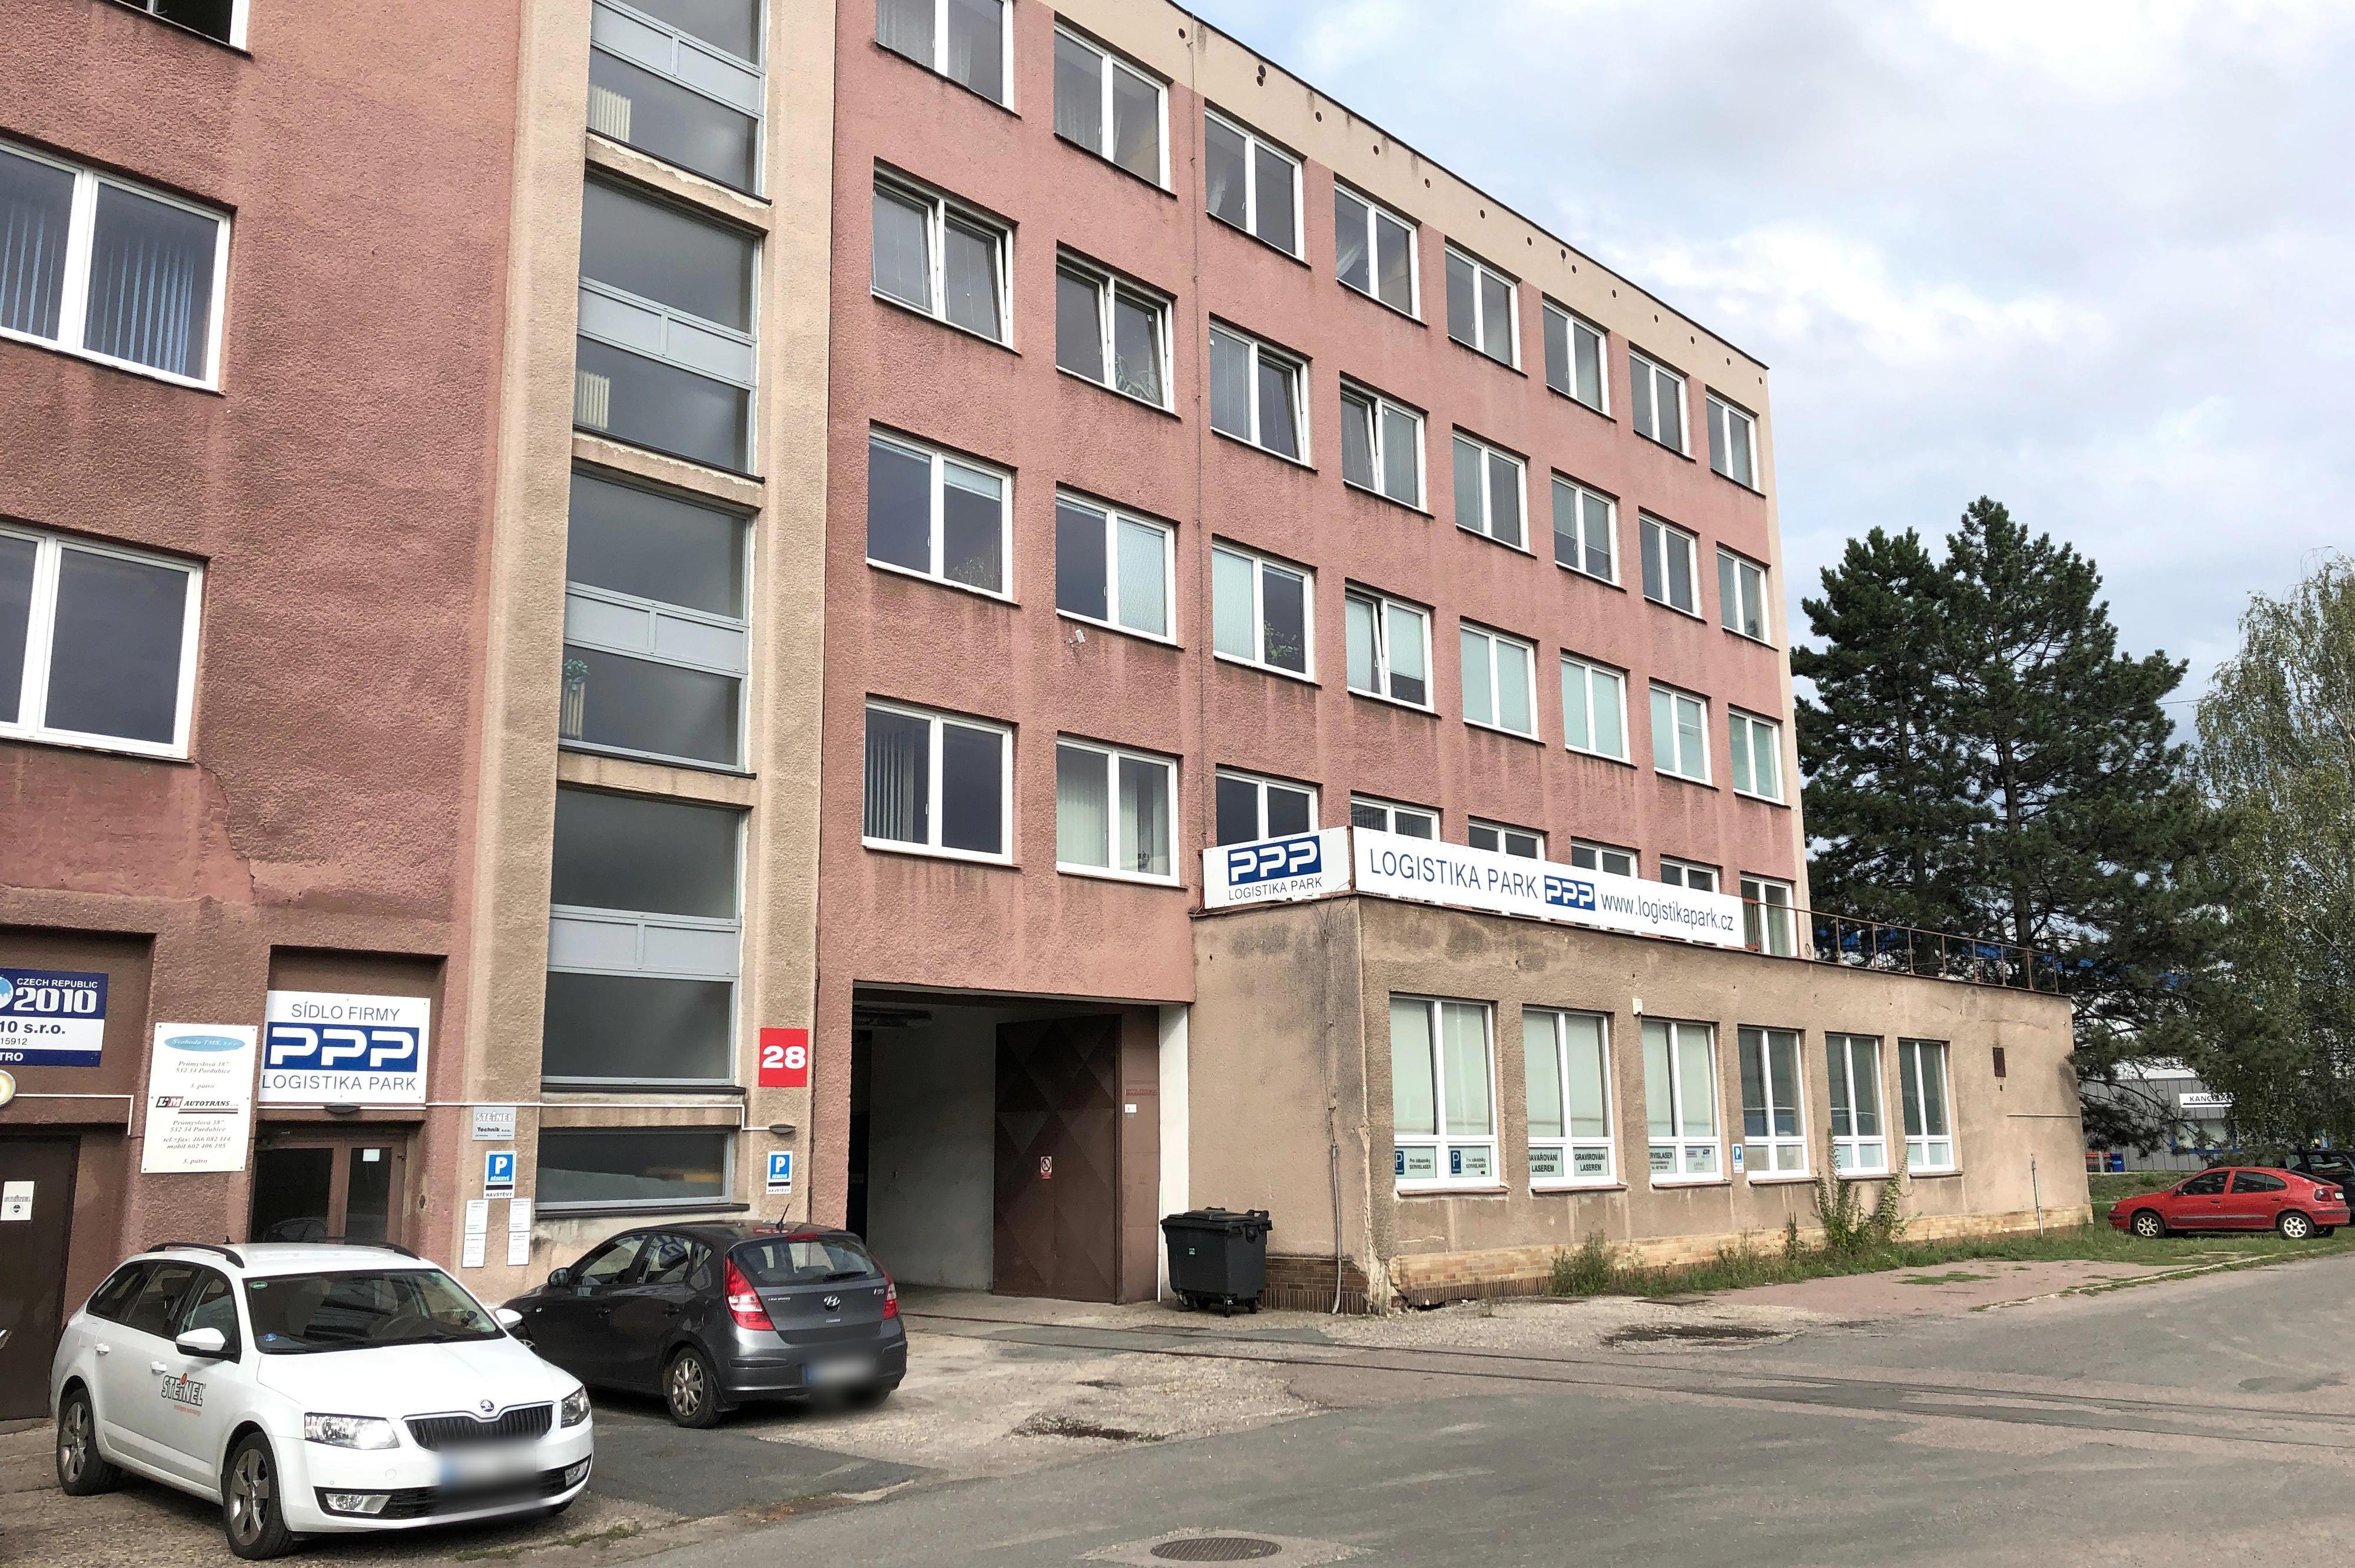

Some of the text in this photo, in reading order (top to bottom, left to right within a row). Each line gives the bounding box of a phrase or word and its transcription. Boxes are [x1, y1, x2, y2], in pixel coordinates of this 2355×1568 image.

[1230, 841, 1318, 882] PPP
[1228, 876, 1323, 901] LOGISTIKA PARK
[1369, 848, 1734, 932] LOGISTIKA PARK PPP www.logistikapark.cz
[16, 978, 98, 988] CZECH REPUBLIC
[14, 986, 97, 1014] 2010
[291, 1001, 400, 1021] SÍDLO FIRMY
[24, 1023, 66, 1035] s.r.o.
[270, 1026, 414, 1067] PPP
[762, 1045, 806, 1069] 28
[262, 1074, 416, 1090] LOGISTIKA PARK
[495, 1157, 508, 1174] P
[775, 1157, 786, 1173] P
[1531, 1164, 1555, 1172] LASEREM
